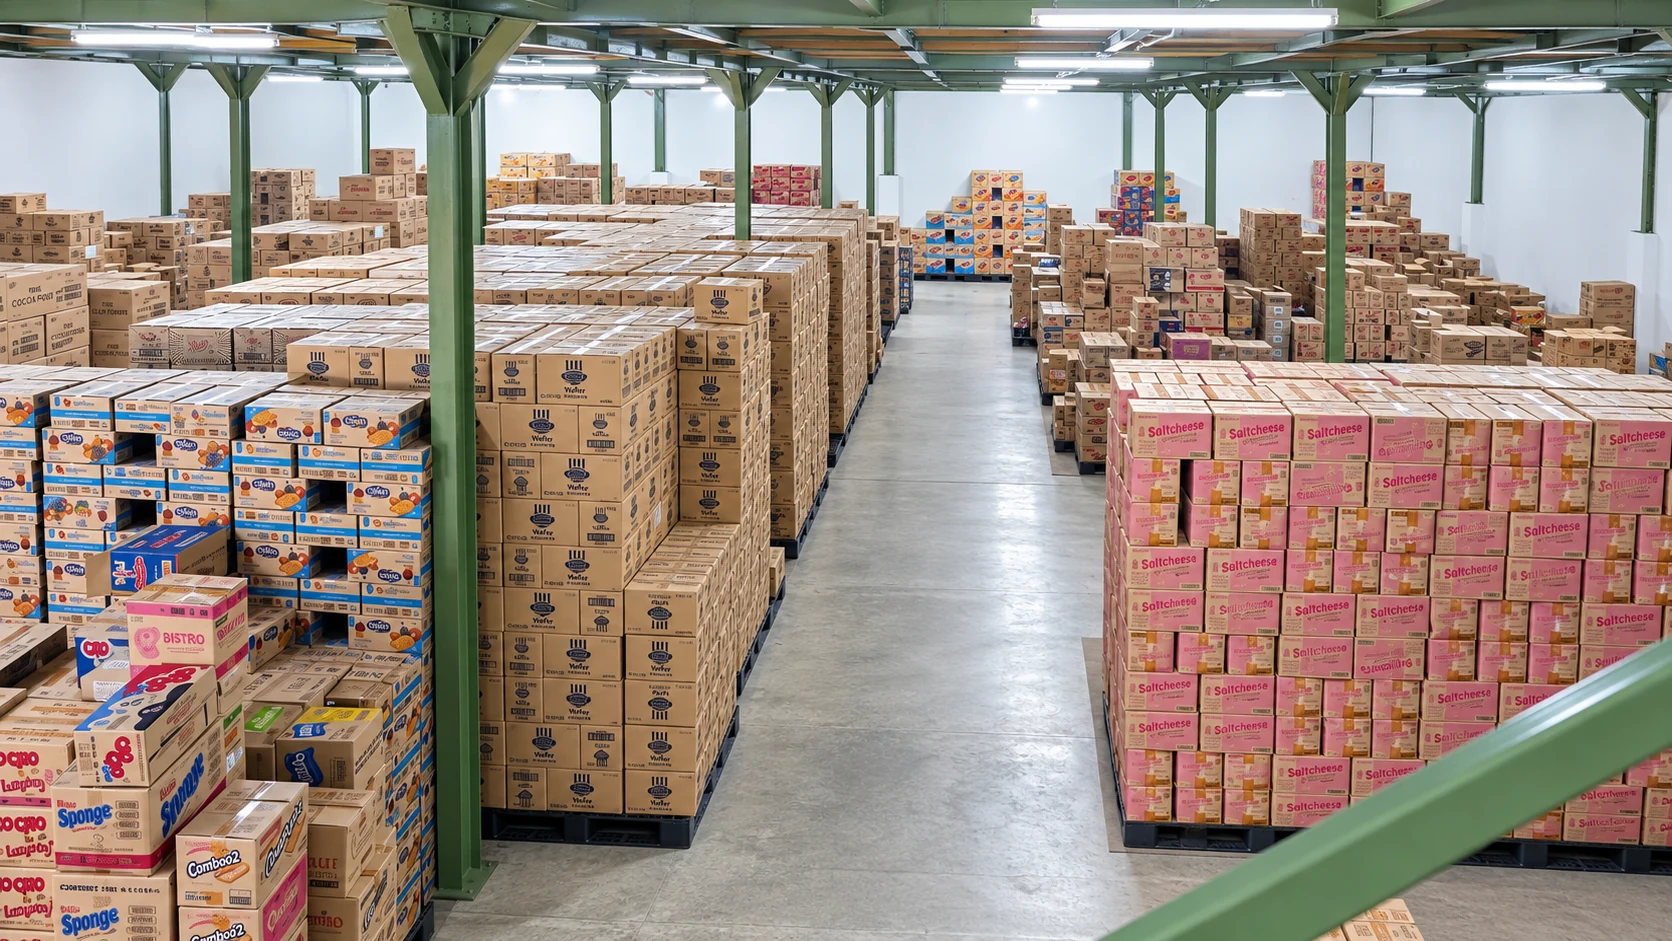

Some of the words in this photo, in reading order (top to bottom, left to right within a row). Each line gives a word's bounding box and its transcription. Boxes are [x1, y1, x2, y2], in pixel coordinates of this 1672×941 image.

[1148, 421, 1204, 438] Saltcheese
[1229, 423, 1285, 440] Saltcheese
[1307, 423, 1362, 440] Saltcheese
[1609, 429, 1666, 446] Saltcheese
[1383, 471, 1437, 489] Saltcheese
[1524, 521, 1580, 538] Saltcheese
[1141, 555, 1197, 571] Saltcheese
[1221, 557, 1277, 573] Saltcheese
[1295, 601, 1349, 616] Saltcheese
[1596, 612, 1654, 627] Saltcheese
[163, 632, 205, 645] BISTRO
[1138, 680, 1191, 693] Saltcheese
[1214, 682, 1268, 696] Saltcheese
[1288, 764, 1343, 777] Saltcheese
[58, 804, 112, 828] Sponge
[187, 850, 241, 878] Comboo2
[61, 908, 119, 936] Sponge
